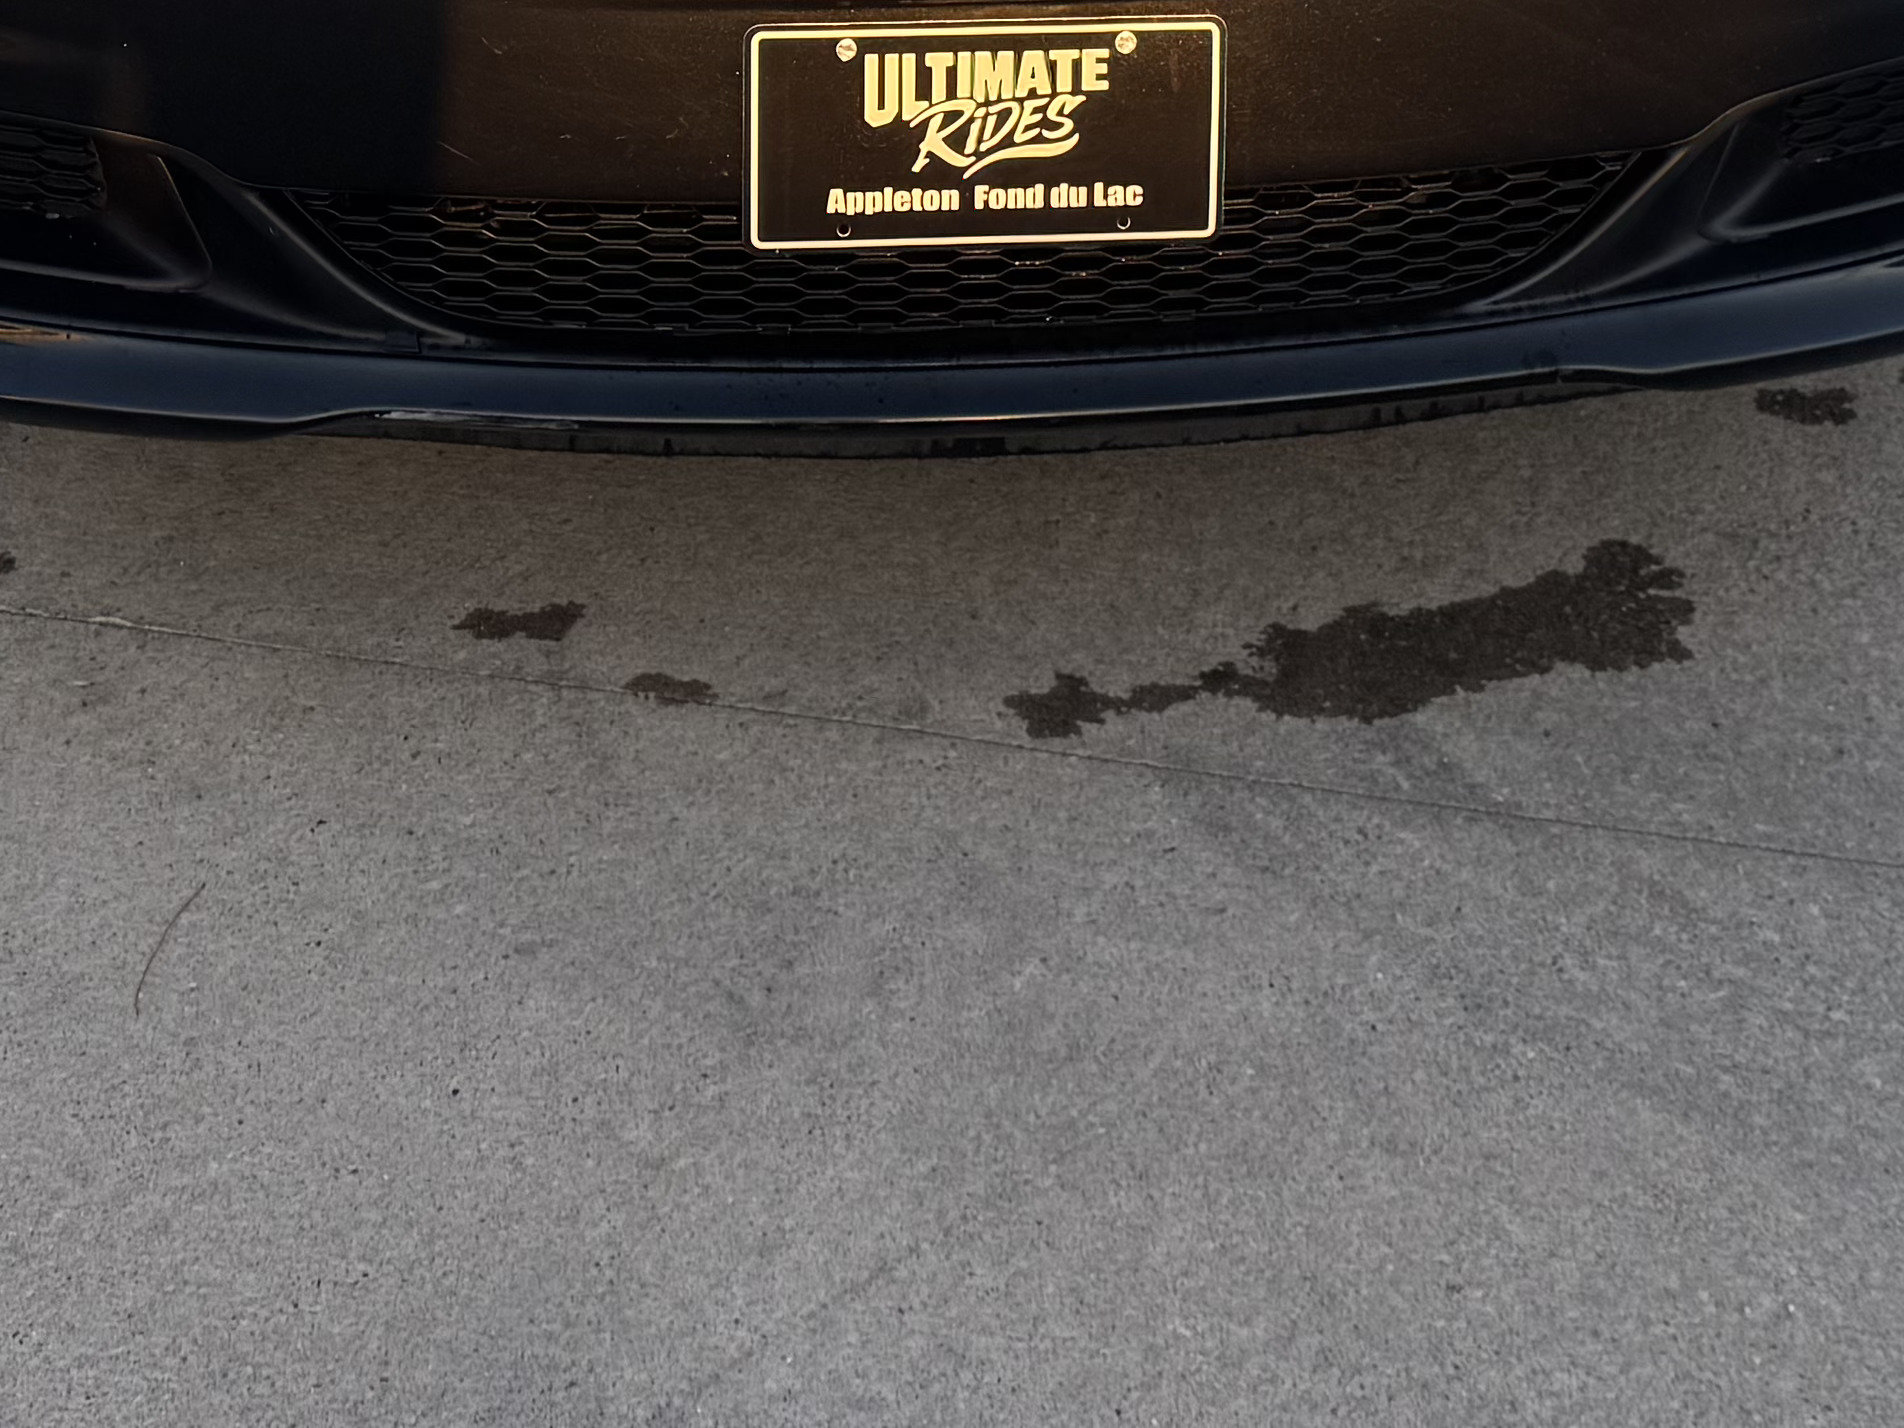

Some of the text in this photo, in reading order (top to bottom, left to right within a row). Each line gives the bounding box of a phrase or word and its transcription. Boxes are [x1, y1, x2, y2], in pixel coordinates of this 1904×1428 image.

[864, 48, 1110, 128] ULTIMATE
[826, 182, 1144, 216] Appleton Fond du Lac
